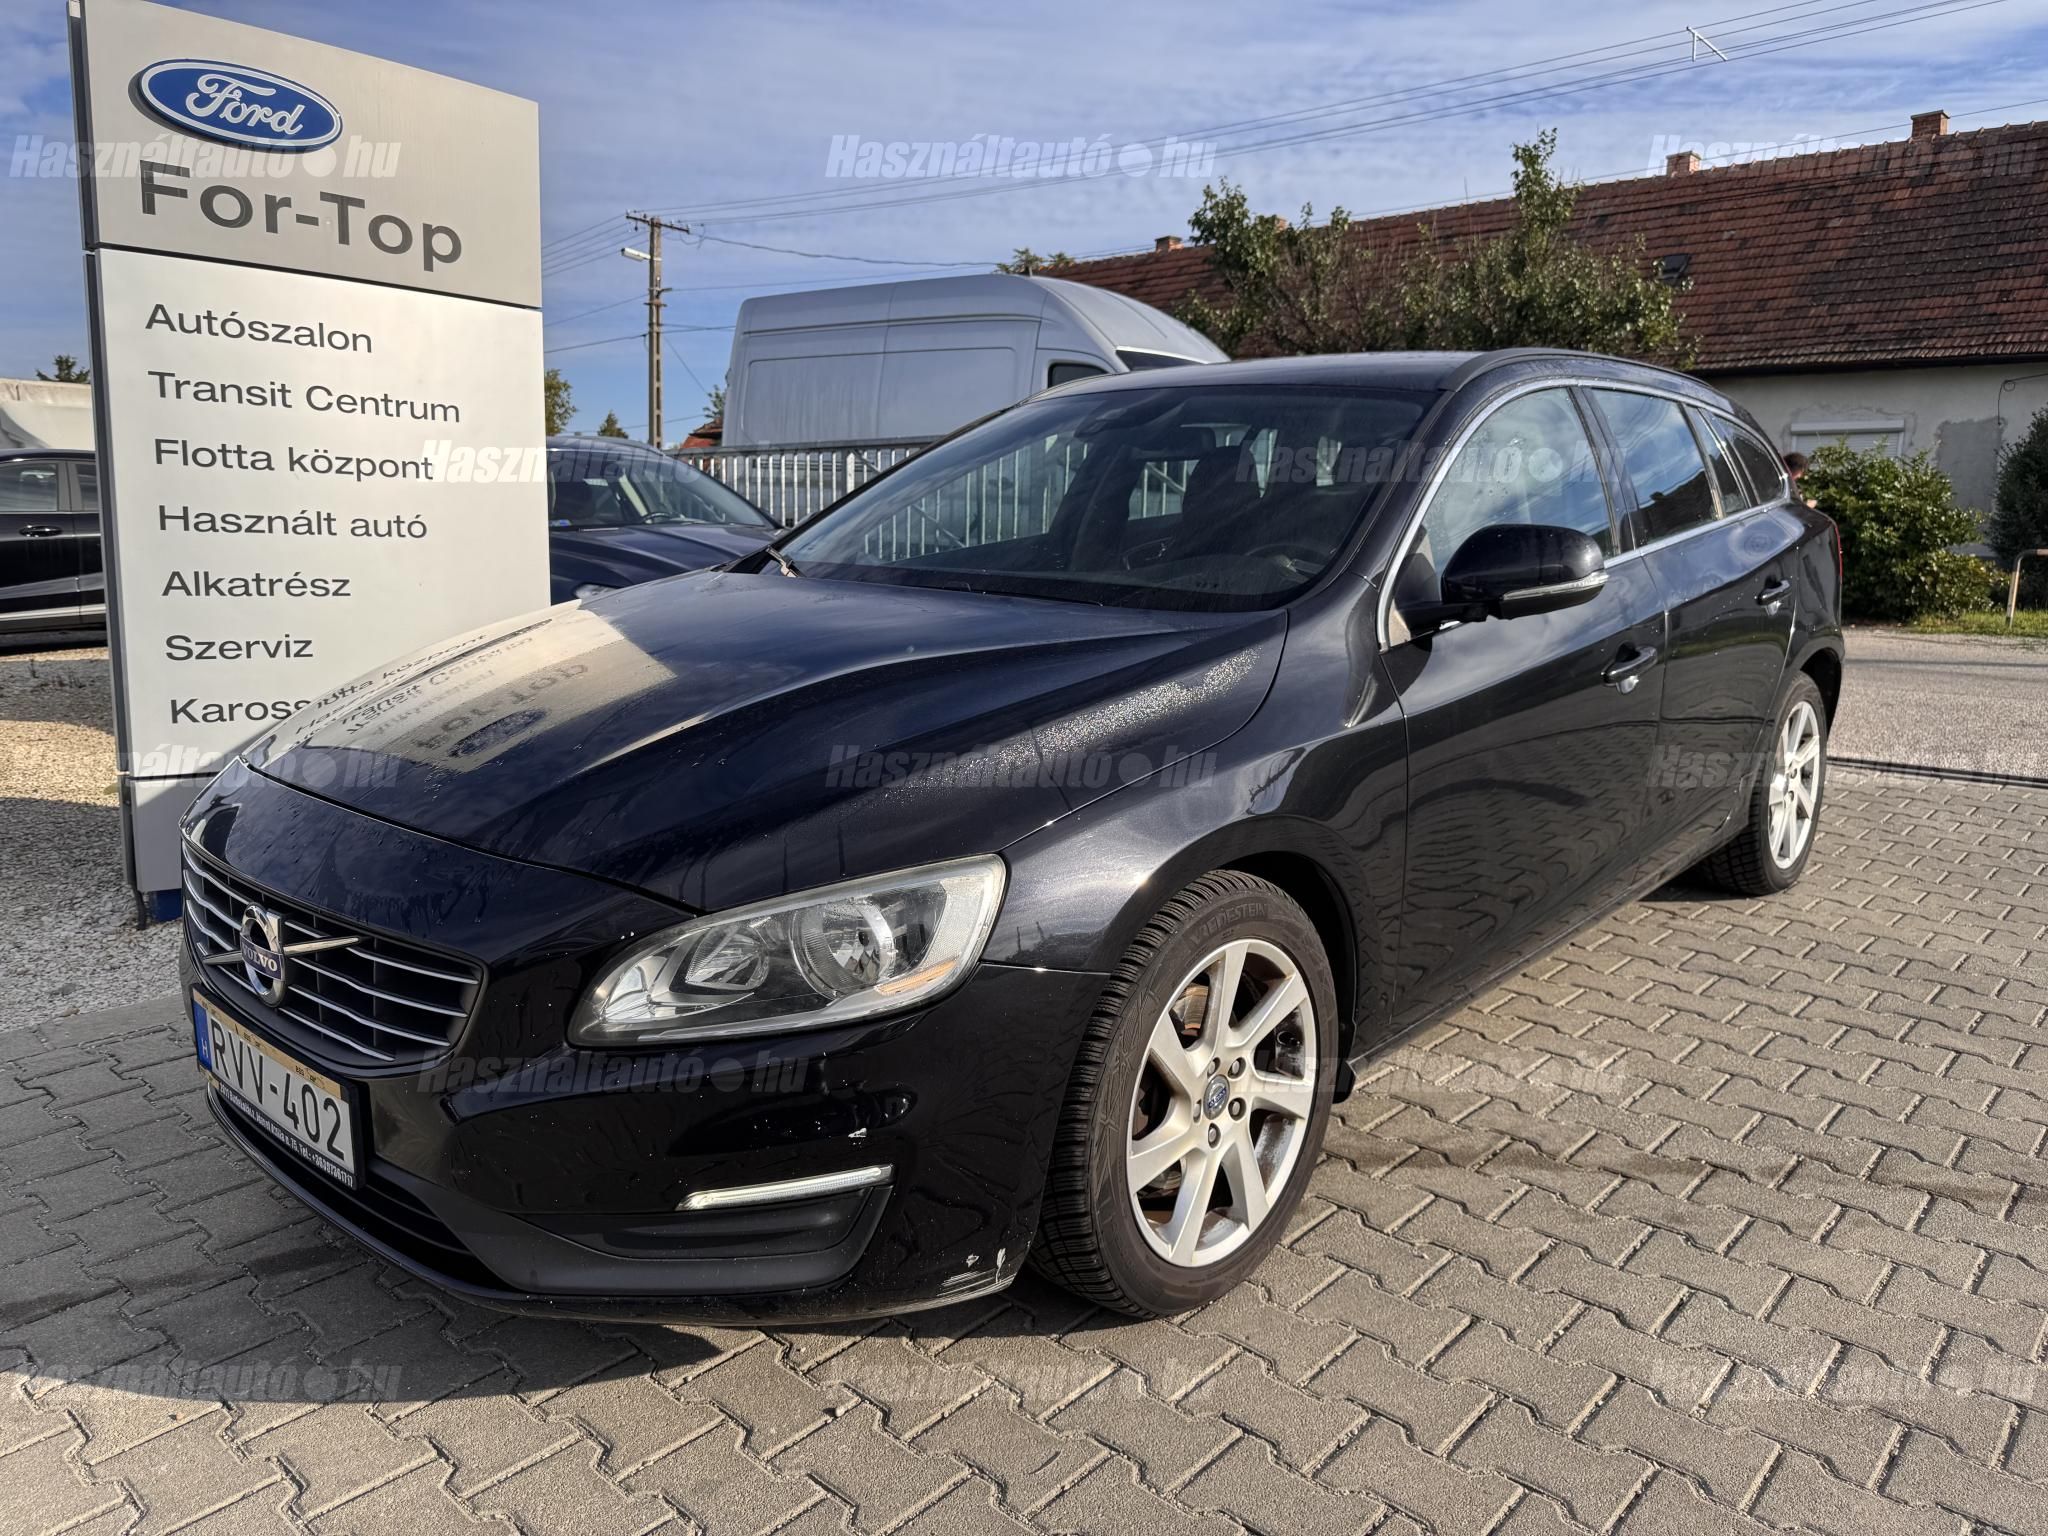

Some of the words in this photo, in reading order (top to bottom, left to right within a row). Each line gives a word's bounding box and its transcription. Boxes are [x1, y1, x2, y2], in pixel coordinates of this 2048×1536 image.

[186, 73, 305, 135] Ford
[139, 159, 463, 272] For-Top
[145, 303, 373, 353] Autószalon
[147, 370, 293, 409] Transit
[305, 385, 460, 423] Centrum
[154, 438, 275, 471] Flotta
[288, 446, 434, 482] központ
[158, 505, 337, 536] Használt
[350, 514, 428, 539] autó
[161, 570, 352, 597] Alkatrész
[165, 634, 314, 661] Szerviz
[241, 942, 279, 973] VOLVO
[209, 1017, 346, 1162] RVV-402
